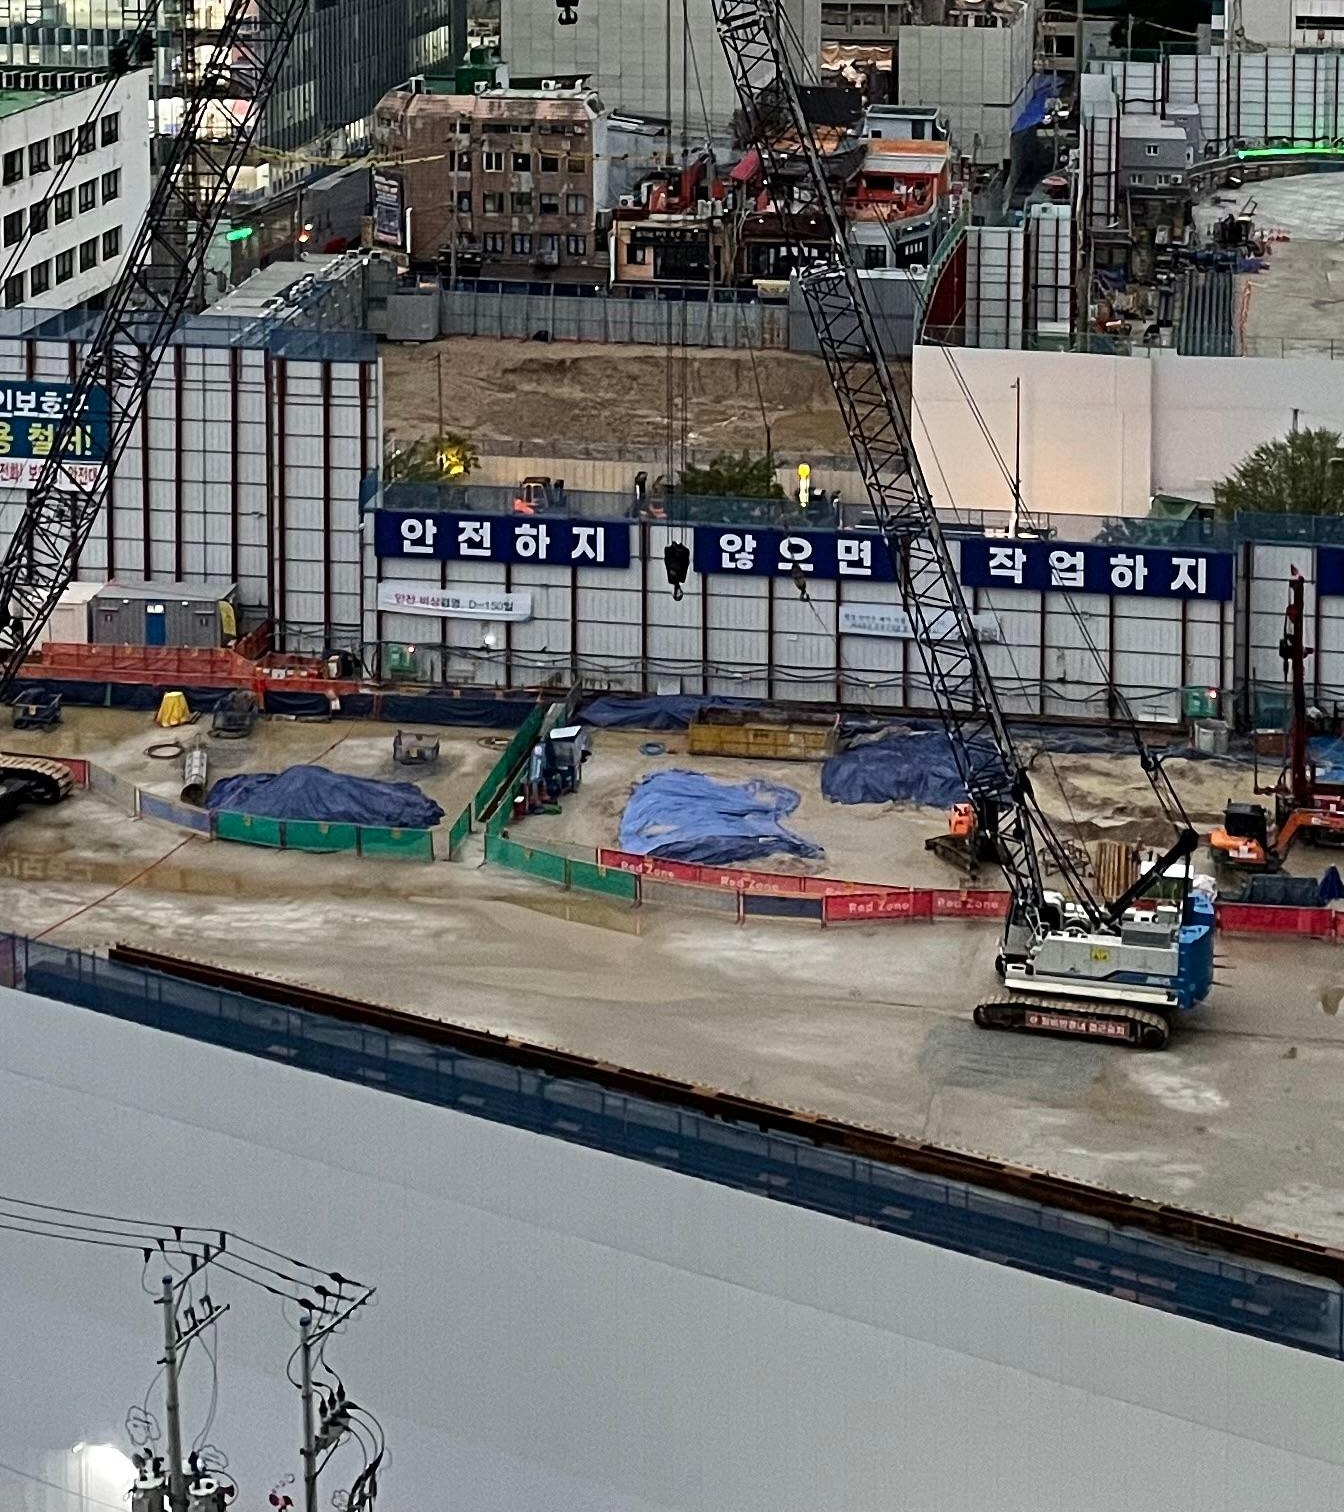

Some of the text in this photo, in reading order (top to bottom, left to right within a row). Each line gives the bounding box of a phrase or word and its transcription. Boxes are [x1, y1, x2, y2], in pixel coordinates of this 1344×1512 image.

[400, 519, 605, 562] 안전하지
[719, 533, 872, 576] 않으면
[988, 546, 1207, 594] 작업하지
[621, 860, 675, 879] Red Zone
[719, 875, 747, 890] Red
[848, 901, 911, 914] Red Zone
[937, 898, 999, 910] Red Zone
